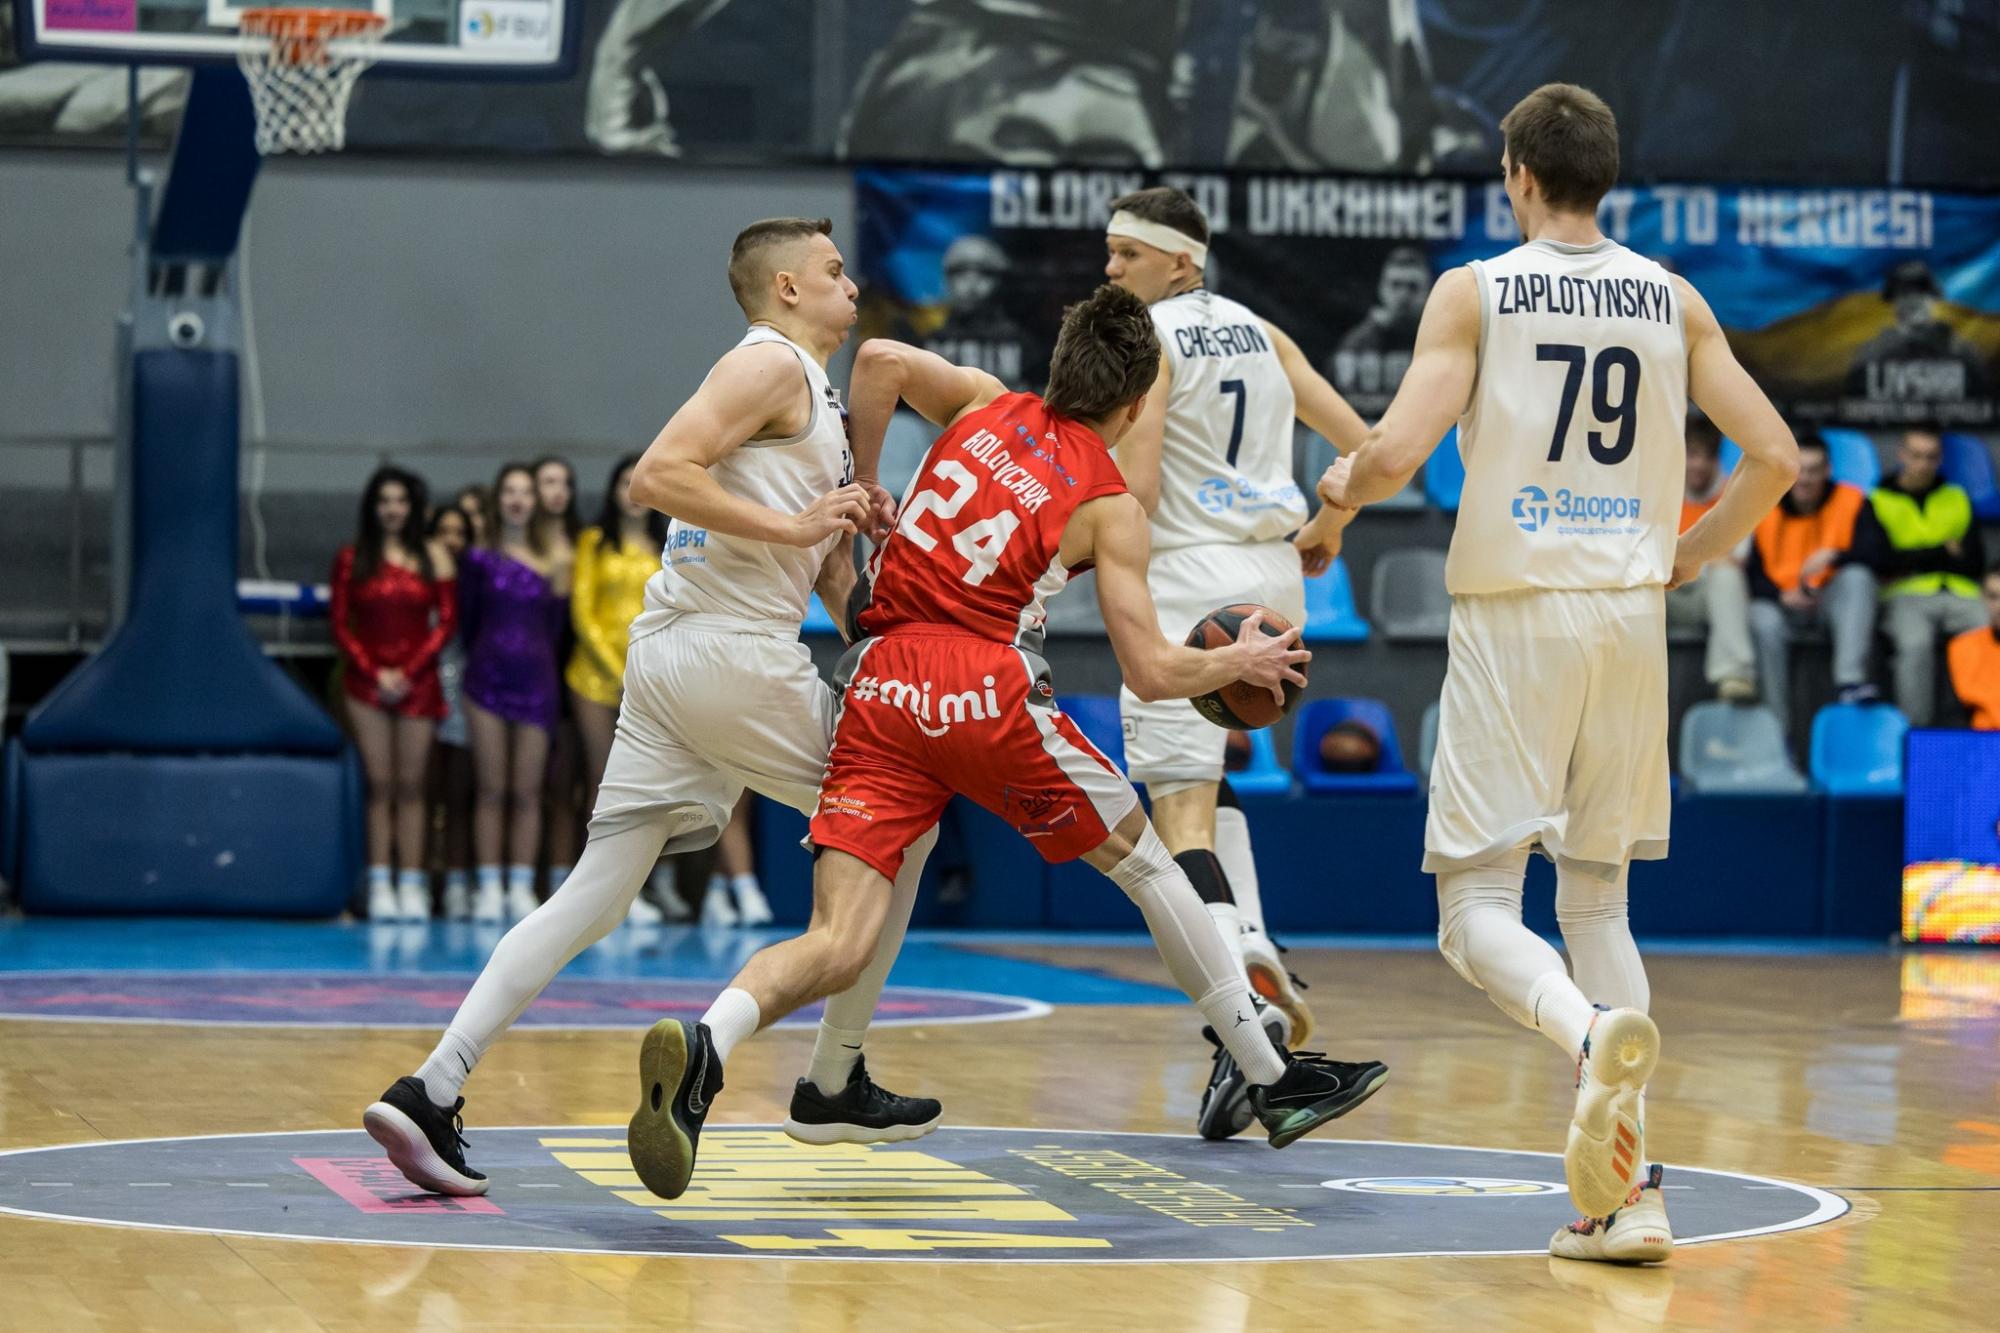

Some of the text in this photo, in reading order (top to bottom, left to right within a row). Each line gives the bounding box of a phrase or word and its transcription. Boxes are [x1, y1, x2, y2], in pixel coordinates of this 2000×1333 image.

[1652, 189, 1718, 246] TO
[1495, 273, 1671, 325] ZAPLOTYNSKYI
[1219, 379, 1247, 469] 7
[1536, 343, 1642, 466] 79
[961, 428, 1052, 515] HOLOVCHYK
[895, 459, 1021, 587] 24
